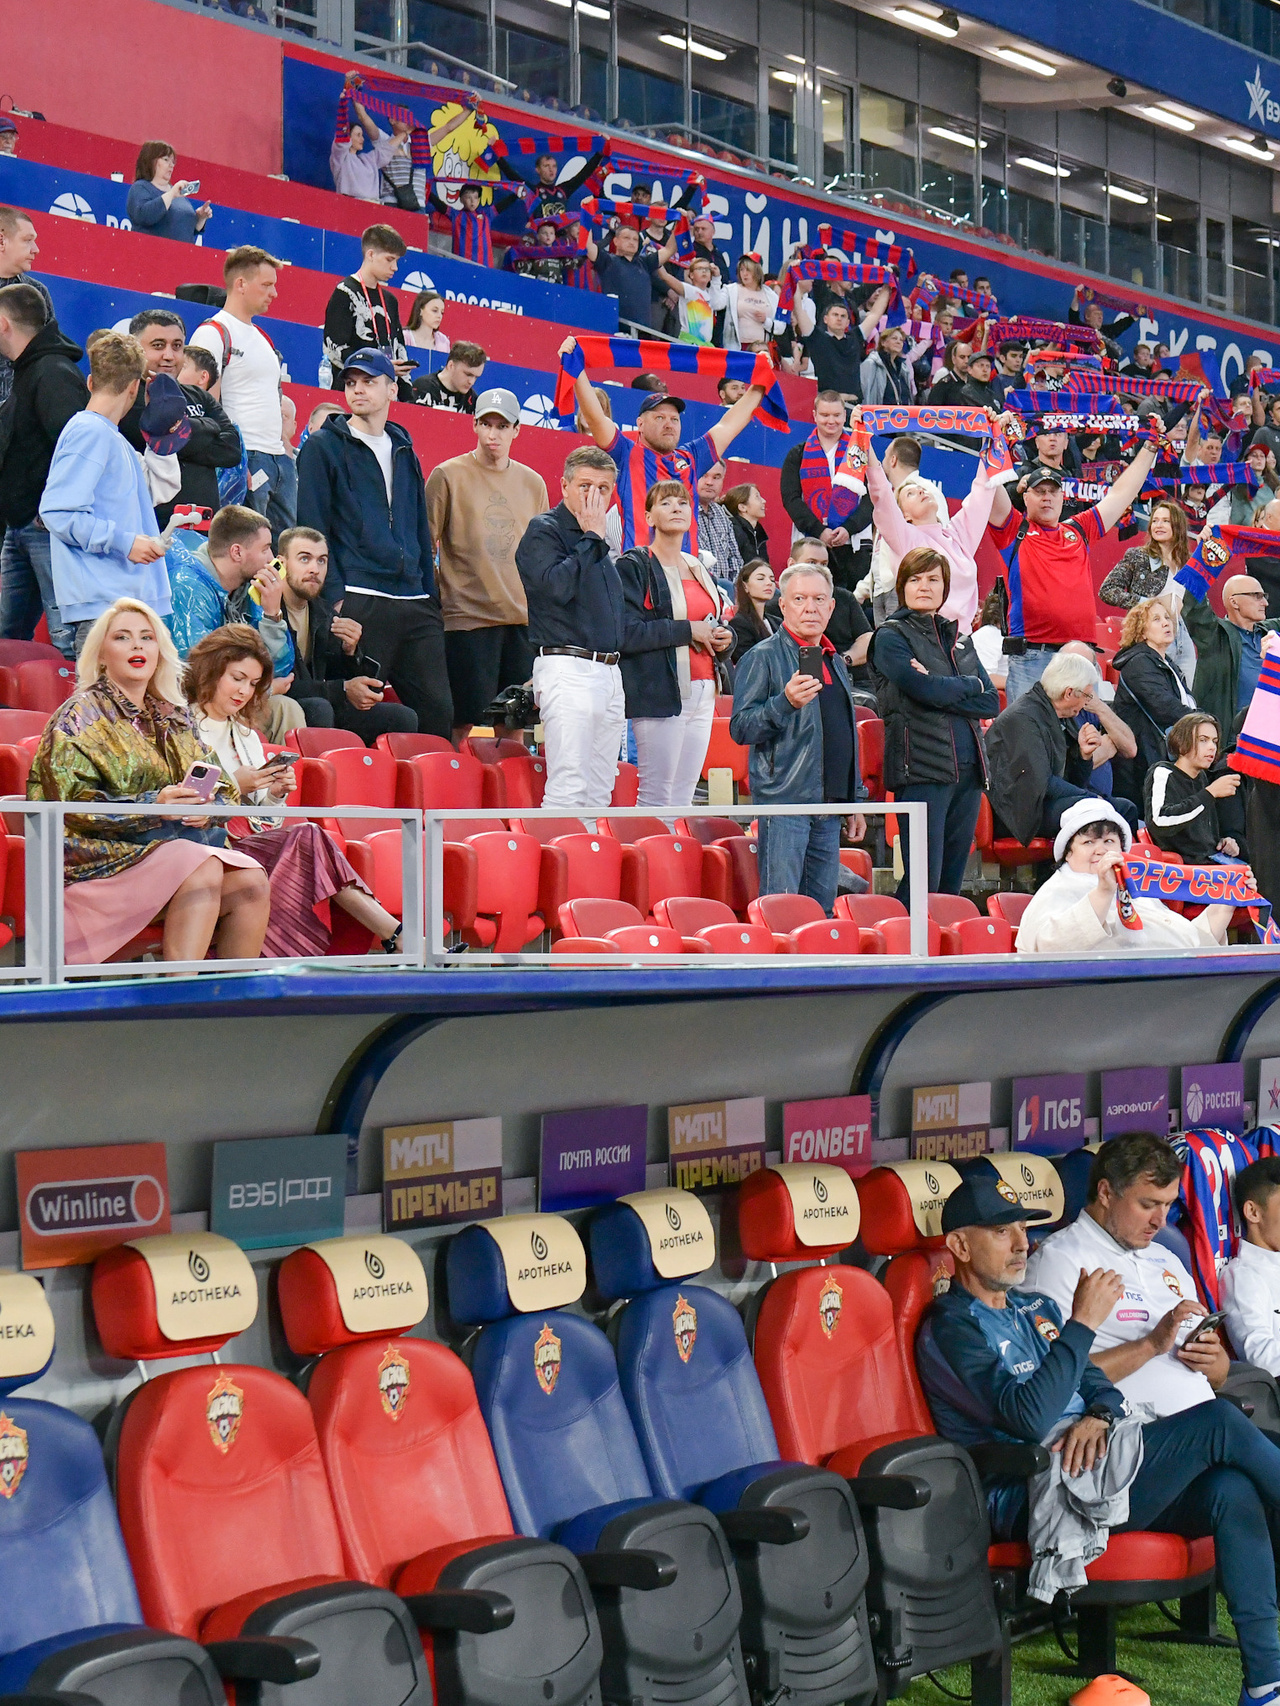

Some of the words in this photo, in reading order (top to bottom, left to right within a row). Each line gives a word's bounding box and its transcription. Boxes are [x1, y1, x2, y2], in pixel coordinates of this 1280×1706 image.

[863, 407, 909, 431] PFC
[917, 408, 990, 433] CSKA
[1087, 414, 1139, 431] ЦСКА
[1126, 861, 1184, 893] PFC
[917, 1093, 957, 1123] МАТЧ
[1105, 1101, 1154, 1118] АЭРОФЛОТ
[1205, 1090, 1241, 1110] РОССЕТИ
[1044, 1097, 1082, 1132] ПСБ
[673, 1111, 724, 1146] МАТЧ
[390, 1131, 450, 1171] МАТЧ
[788, 1122, 869, 1163] FONBET
[558, 1150, 593, 1172] ПОЧТА
[594, 1143, 632, 1167] РОССИИ
[675, 1150, 762, 1190] ПРЕМЬЕР
[38, 1191, 127, 1223] Winline
[391, 1175, 498, 1222] ПРЕМЬЕР
[803, 1204, 850, 1220] APOTHEKA
[658, 1229, 705, 1252] APOTHEKA
[517, 1260, 574, 1283] APOTHEKA
[171, 1284, 242, 1306] APOTHEKA
[352, 1280, 414, 1302] APOTHEKA
[1125, 1291, 1144, 1302] ПСБ
[1013, 1359, 1035, 1375] ПСБ
